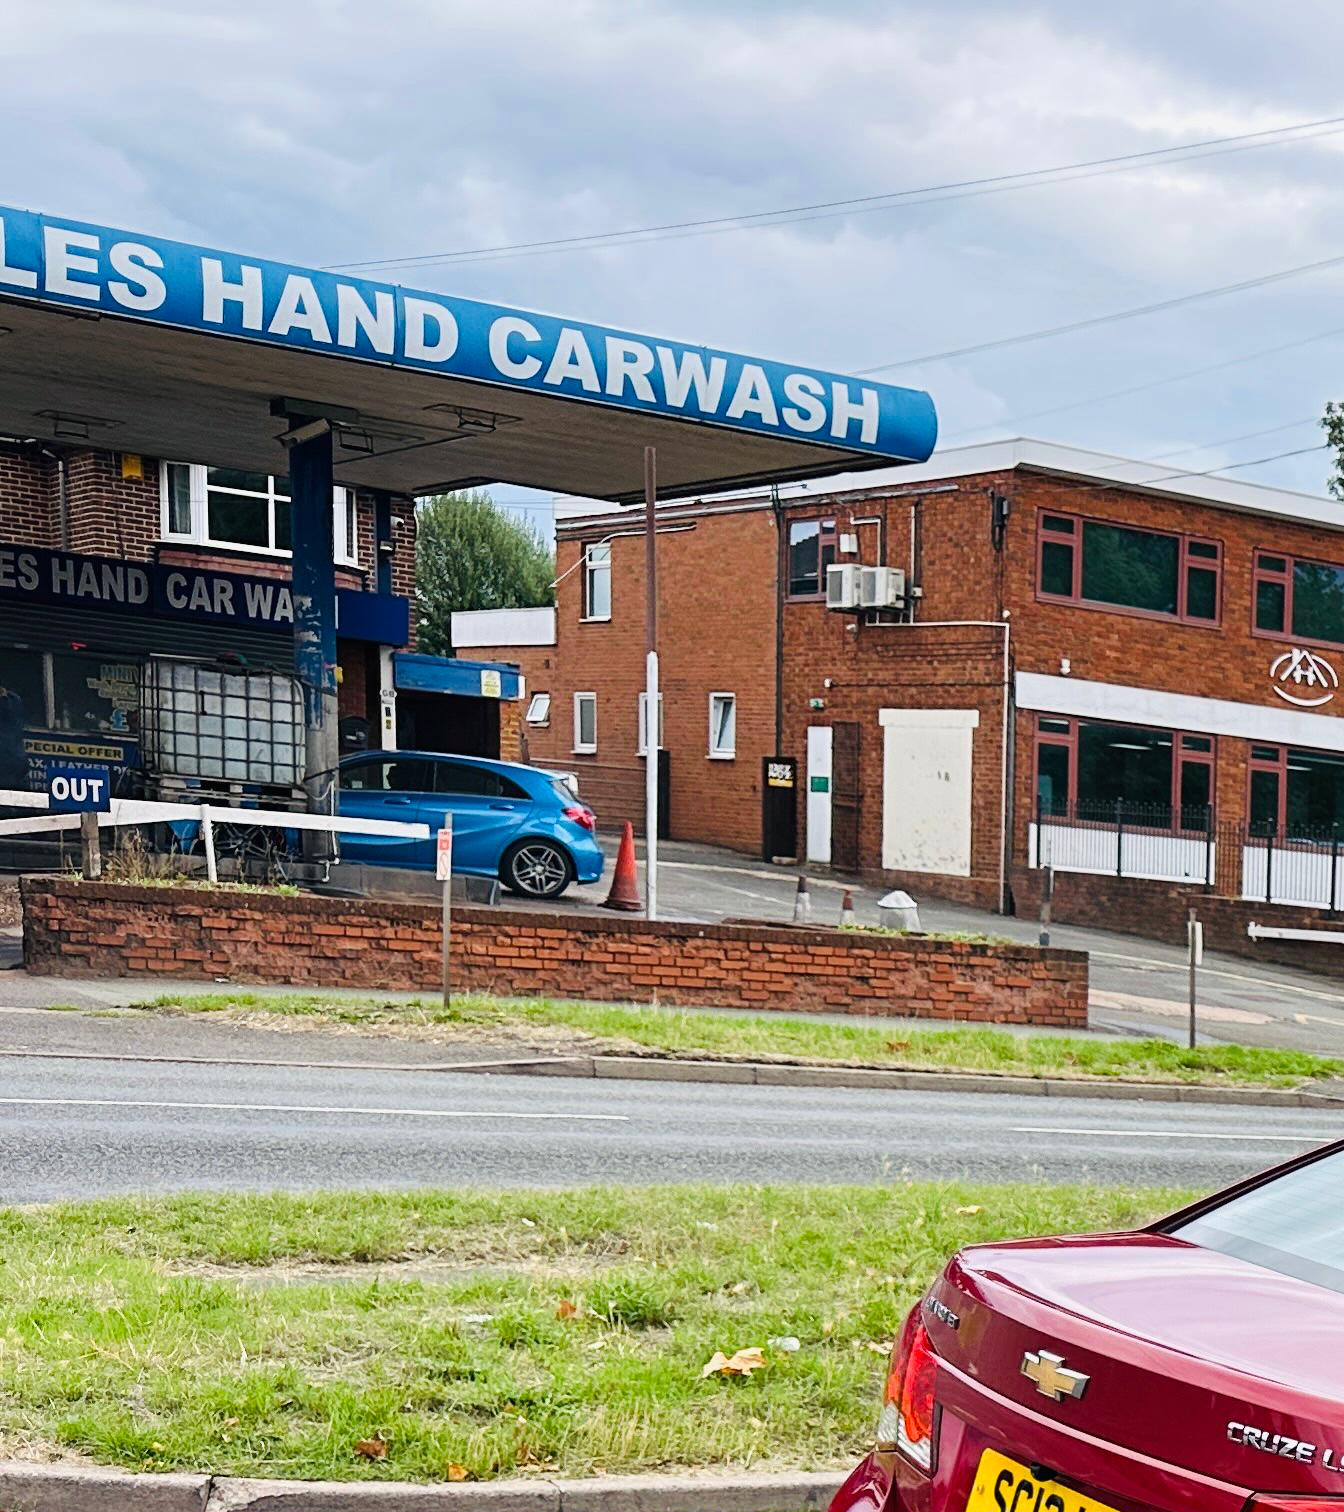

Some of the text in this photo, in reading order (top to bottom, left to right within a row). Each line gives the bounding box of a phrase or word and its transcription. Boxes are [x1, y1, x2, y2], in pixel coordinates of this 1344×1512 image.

[201, 257, 459, 363] HAND
[487, 317, 880, 445] CARWASH
[51, 557, 149, 605] HAND
[166, 572, 236, 616] CAR
[78, 746, 122, 759] OFFER
[51, 776, 104, 803] OUT
[1227, 1421, 1317, 1465] CRUZE
